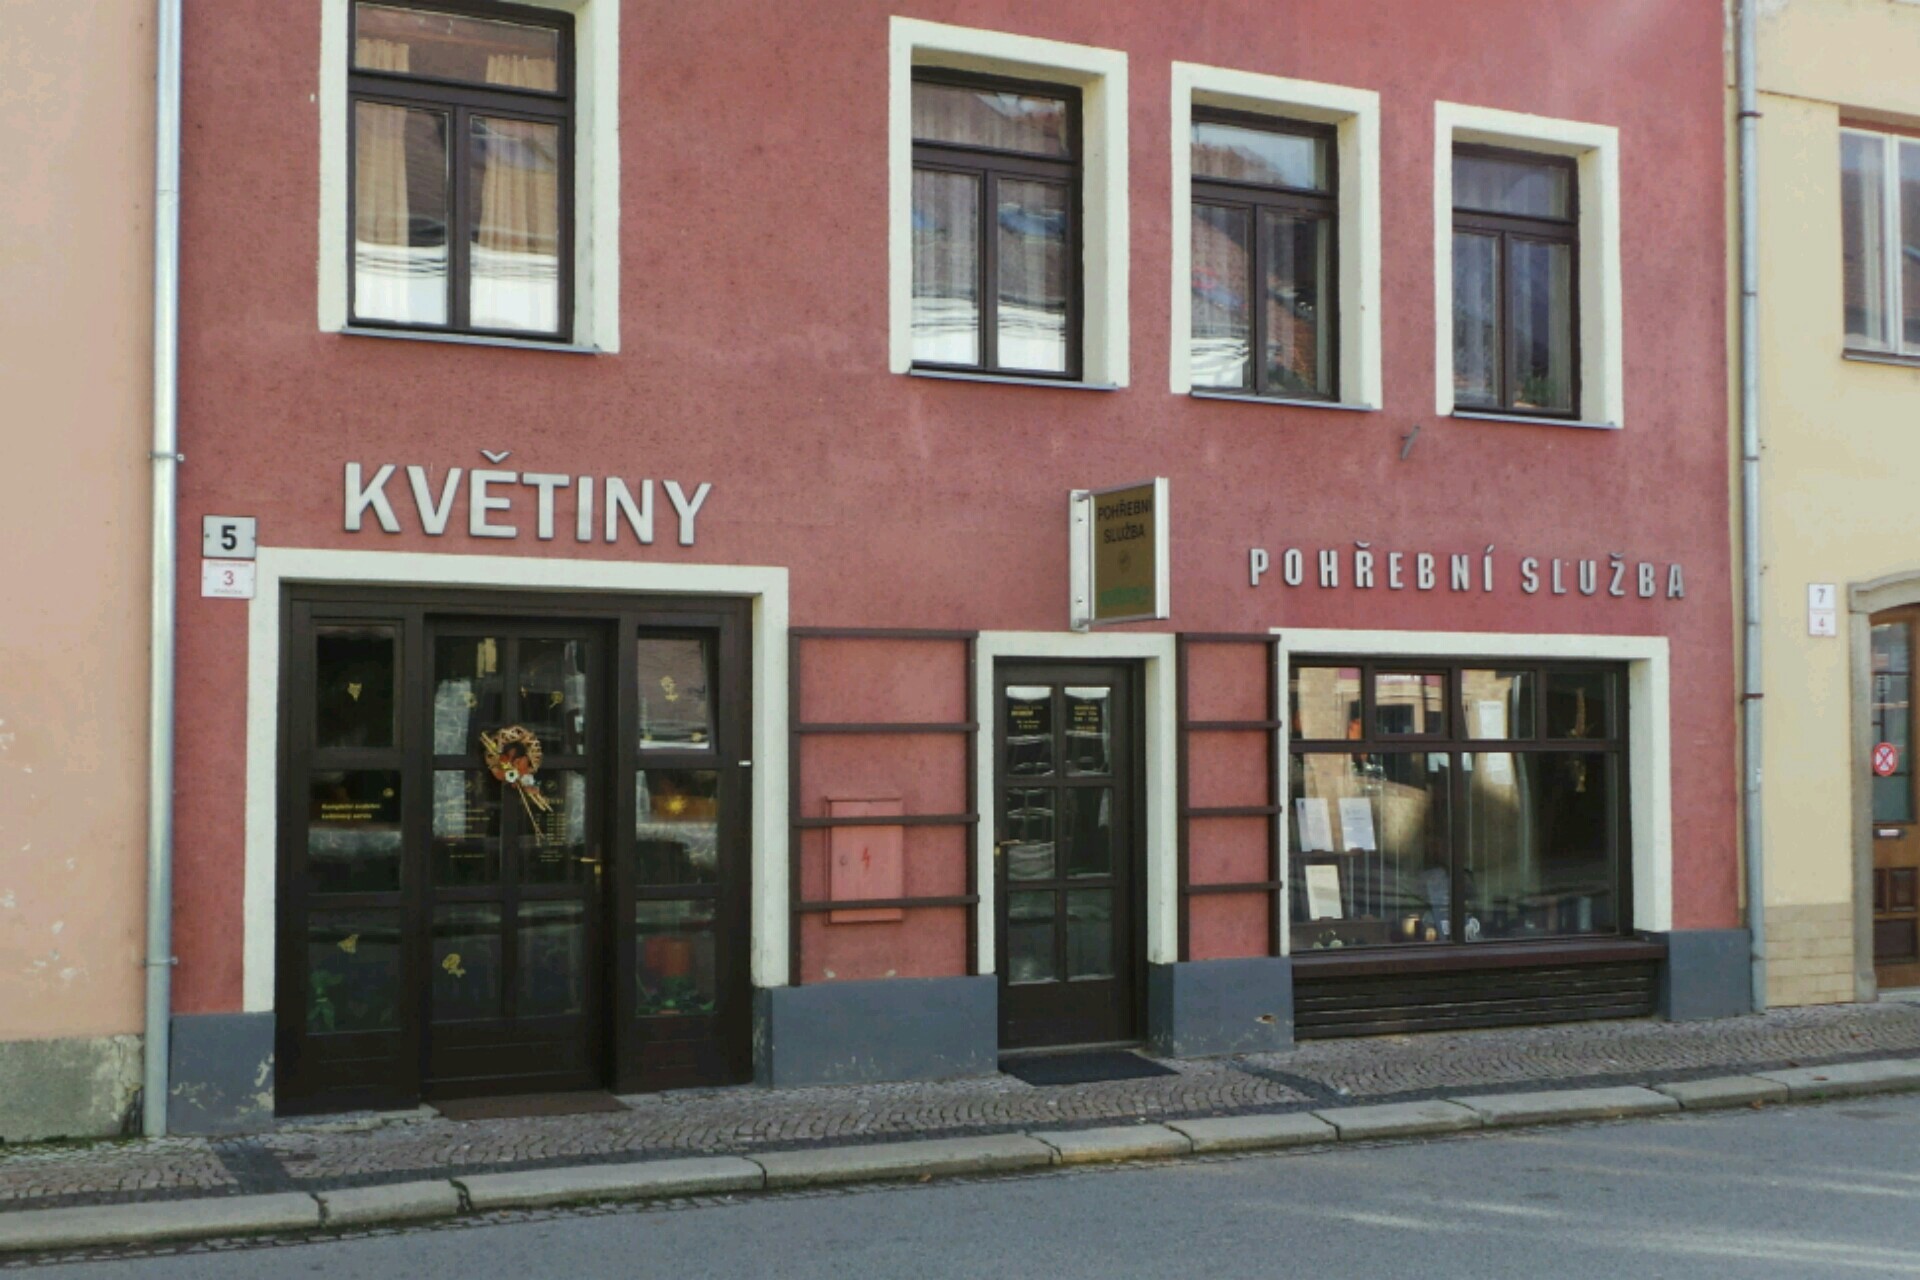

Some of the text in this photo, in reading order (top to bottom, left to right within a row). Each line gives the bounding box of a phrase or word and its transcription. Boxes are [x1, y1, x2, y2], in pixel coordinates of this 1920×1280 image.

[344, 449, 712, 546] KVĚTINY
[220, 524, 238, 551] 5
[223, 569, 235, 587] 3
[1248, 539, 1686, 599] POHŘEBNÍ SLUŽBA
[1818, 588, 1826, 604] 7
